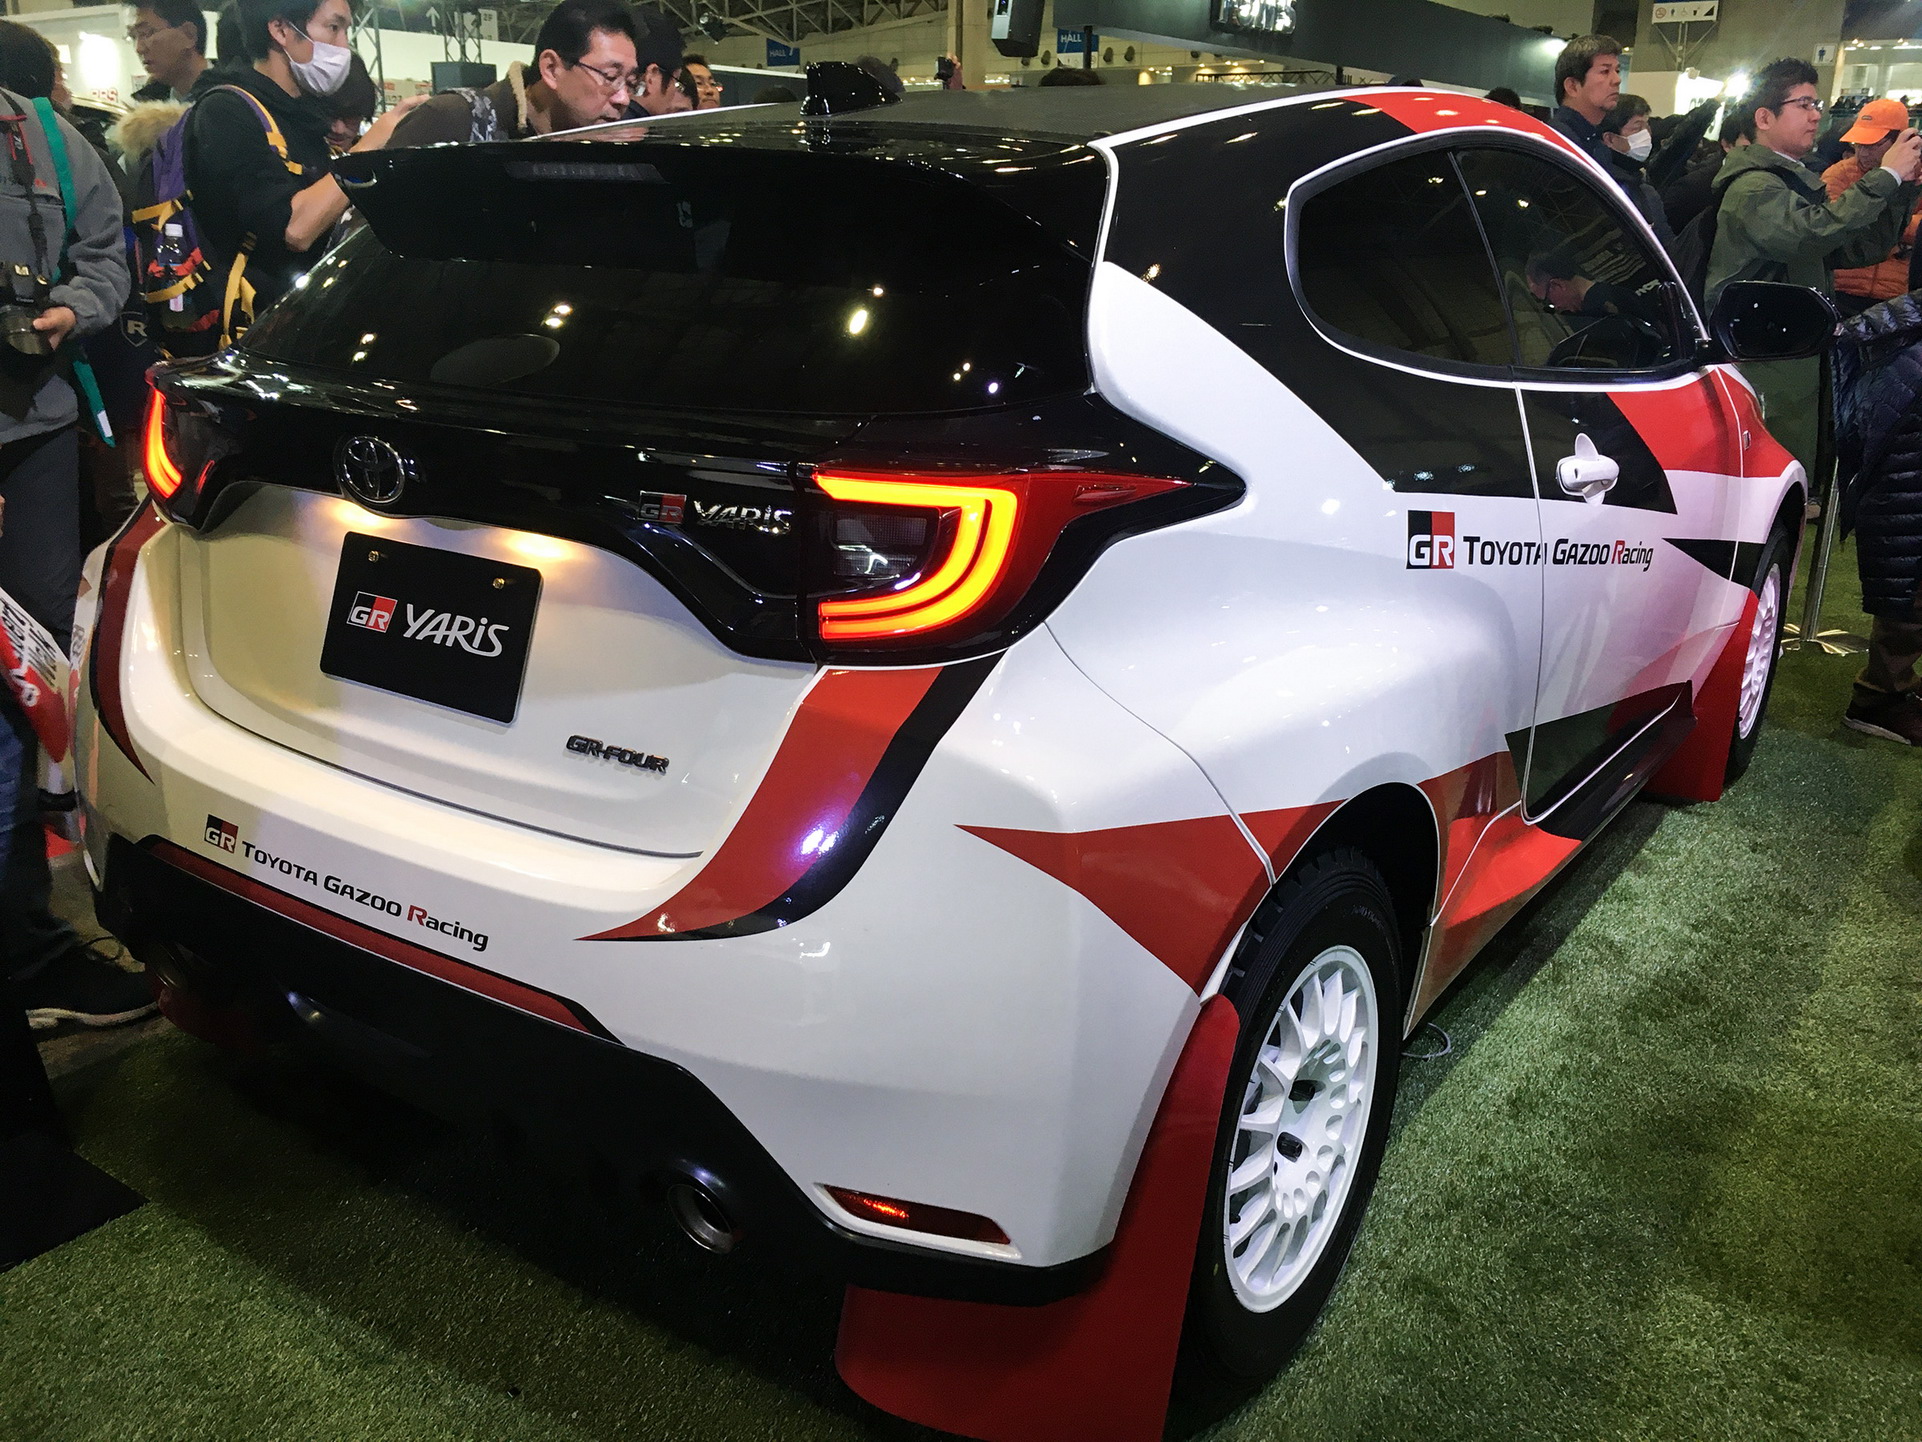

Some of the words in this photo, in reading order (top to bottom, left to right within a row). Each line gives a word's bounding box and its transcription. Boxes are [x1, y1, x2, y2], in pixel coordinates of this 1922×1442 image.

[1060, 33, 1082, 43] HALL
[1408, 534, 1454, 567] GR
[1463, 536, 1547, 565] TOYOTA
[1552, 538, 1610, 565] GAZOO
[1611, 540, 1654, 572] Racing
[242, 841, 318, 887] TOYOTA
[323, 875, 402, 917] GAZOO
[407, 904, 489, 952] Racing
